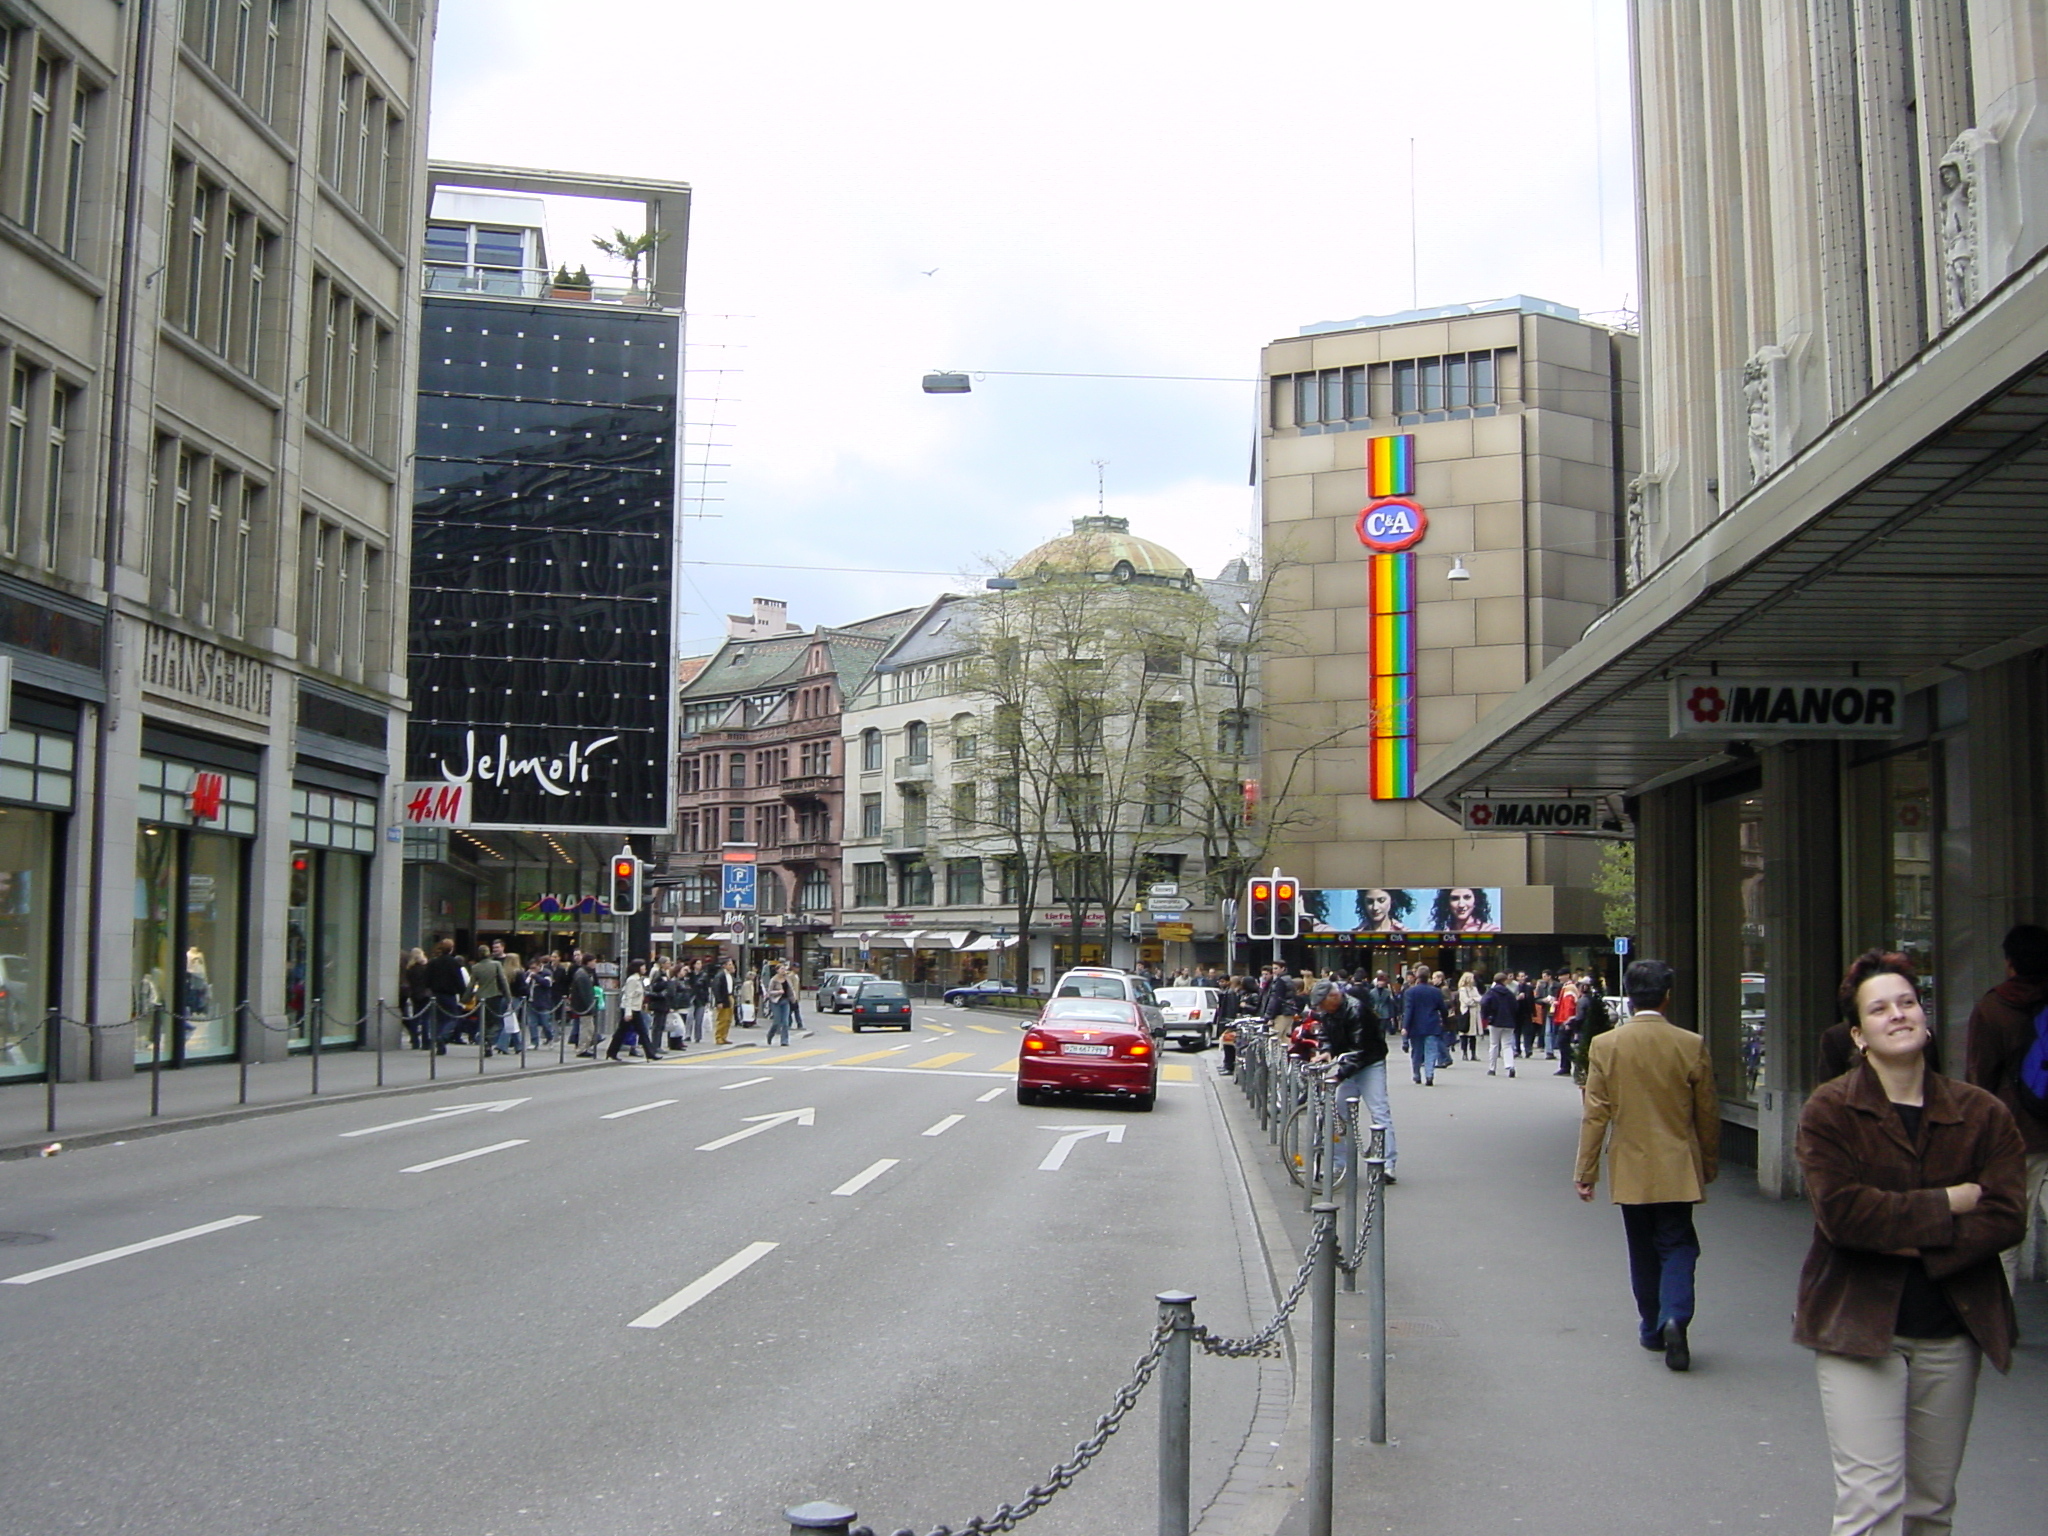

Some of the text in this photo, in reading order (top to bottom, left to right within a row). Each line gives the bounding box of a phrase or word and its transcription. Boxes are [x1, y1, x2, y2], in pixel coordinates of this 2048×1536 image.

[1366, 510, 1414, 536] C&A
[1731, 687, 1896, 724] MANOR
[440, 729, 619, 796] Jelmoli
[407, 785, 463, 824] H&M
[1495, 804, 1592, 826] MANOR
